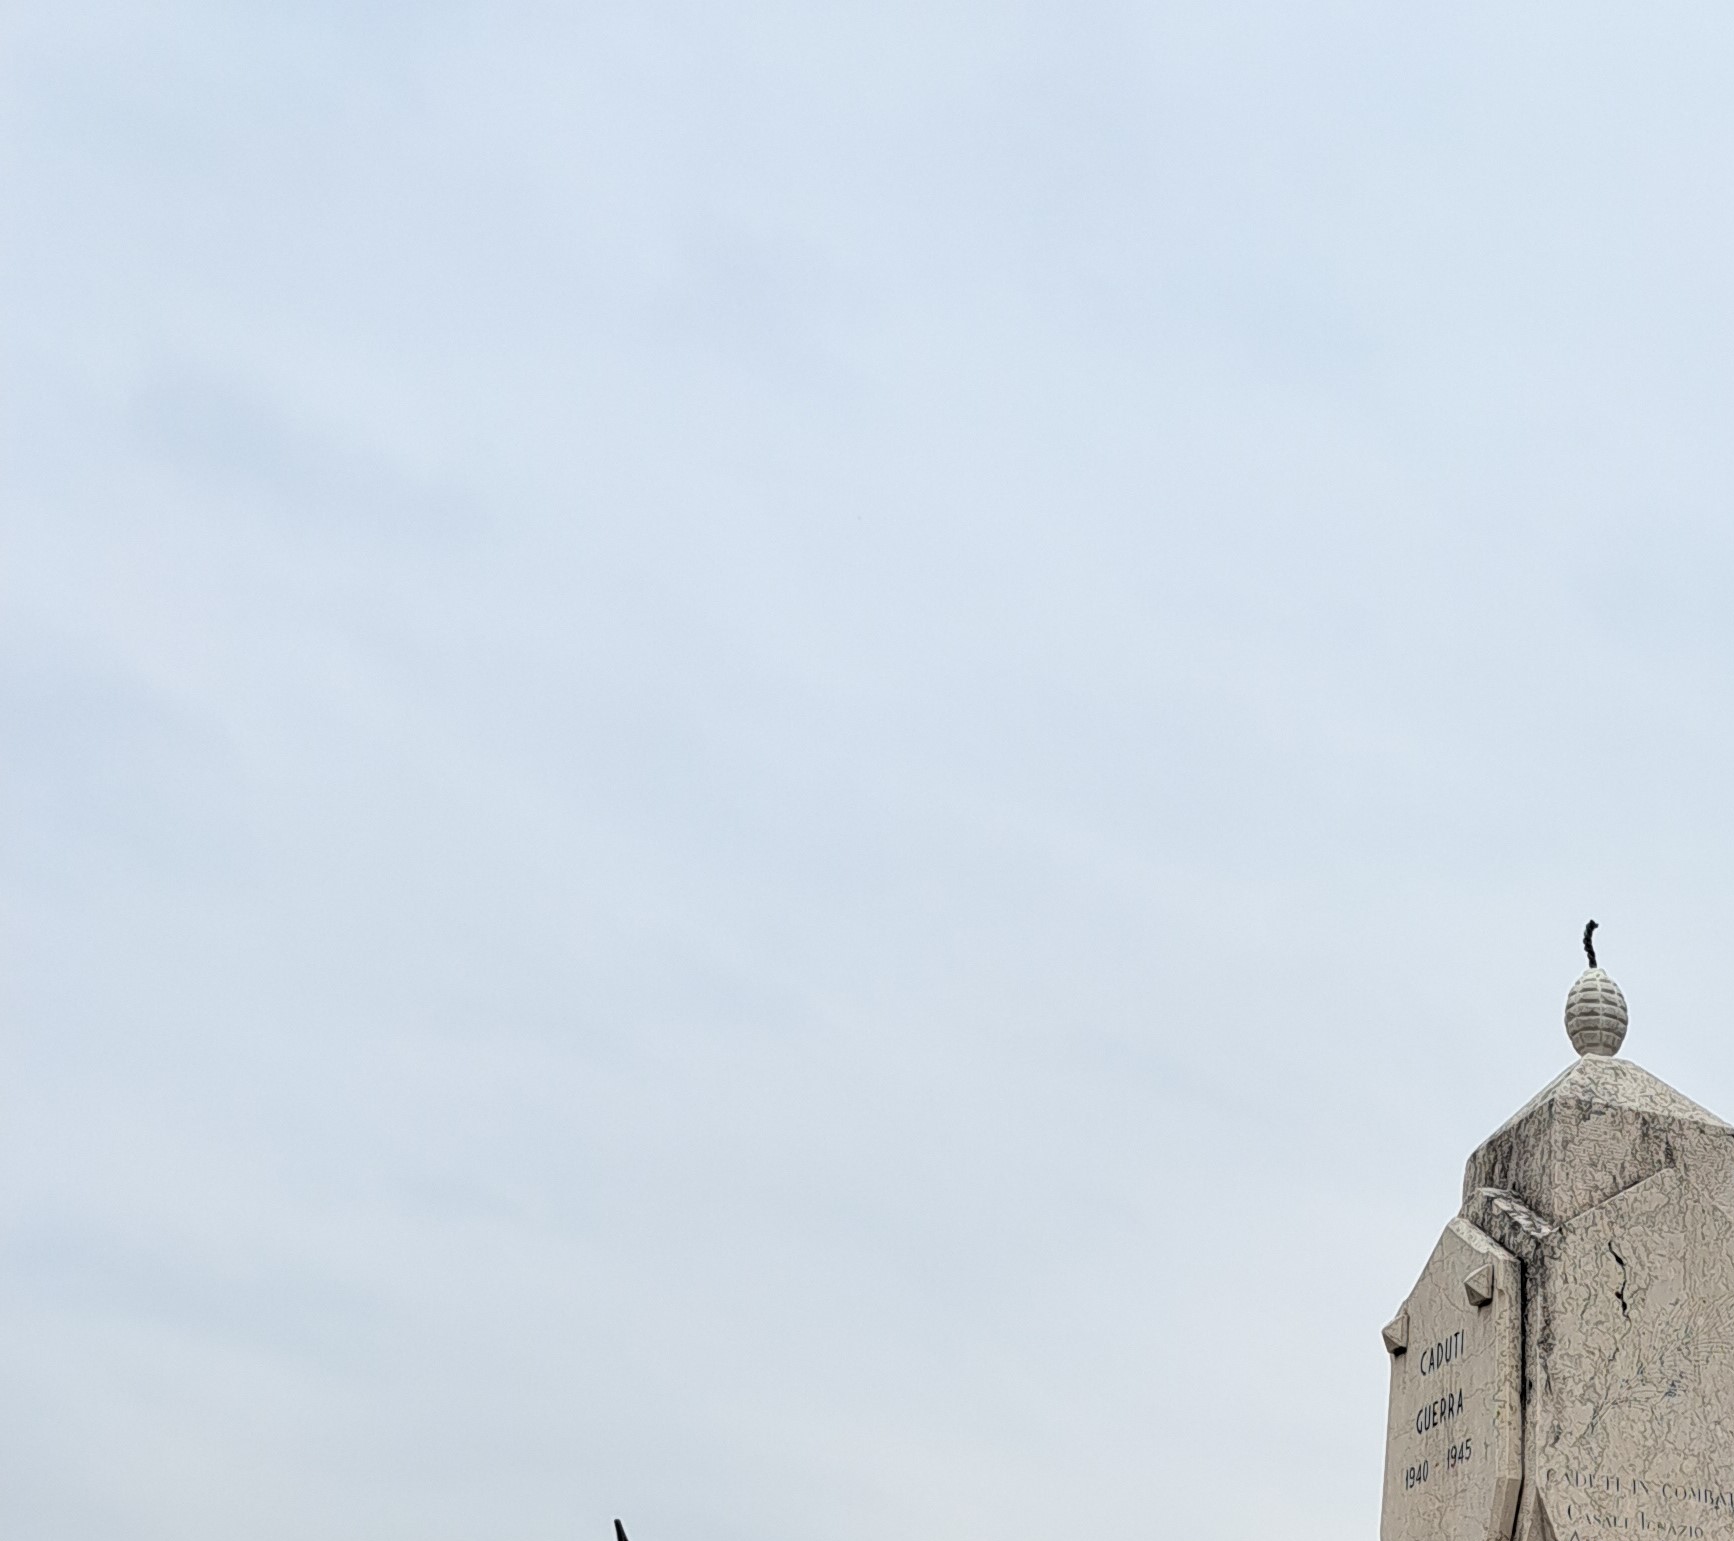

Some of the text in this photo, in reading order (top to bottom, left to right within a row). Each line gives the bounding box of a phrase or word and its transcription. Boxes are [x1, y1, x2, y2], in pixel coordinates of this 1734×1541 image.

[1420, 1329, 1464, 1376] CADUTI
[1416, 1388, 1464, 1435] GUERRA
[1405, 1438, 1472, 1490] 1940 1945
